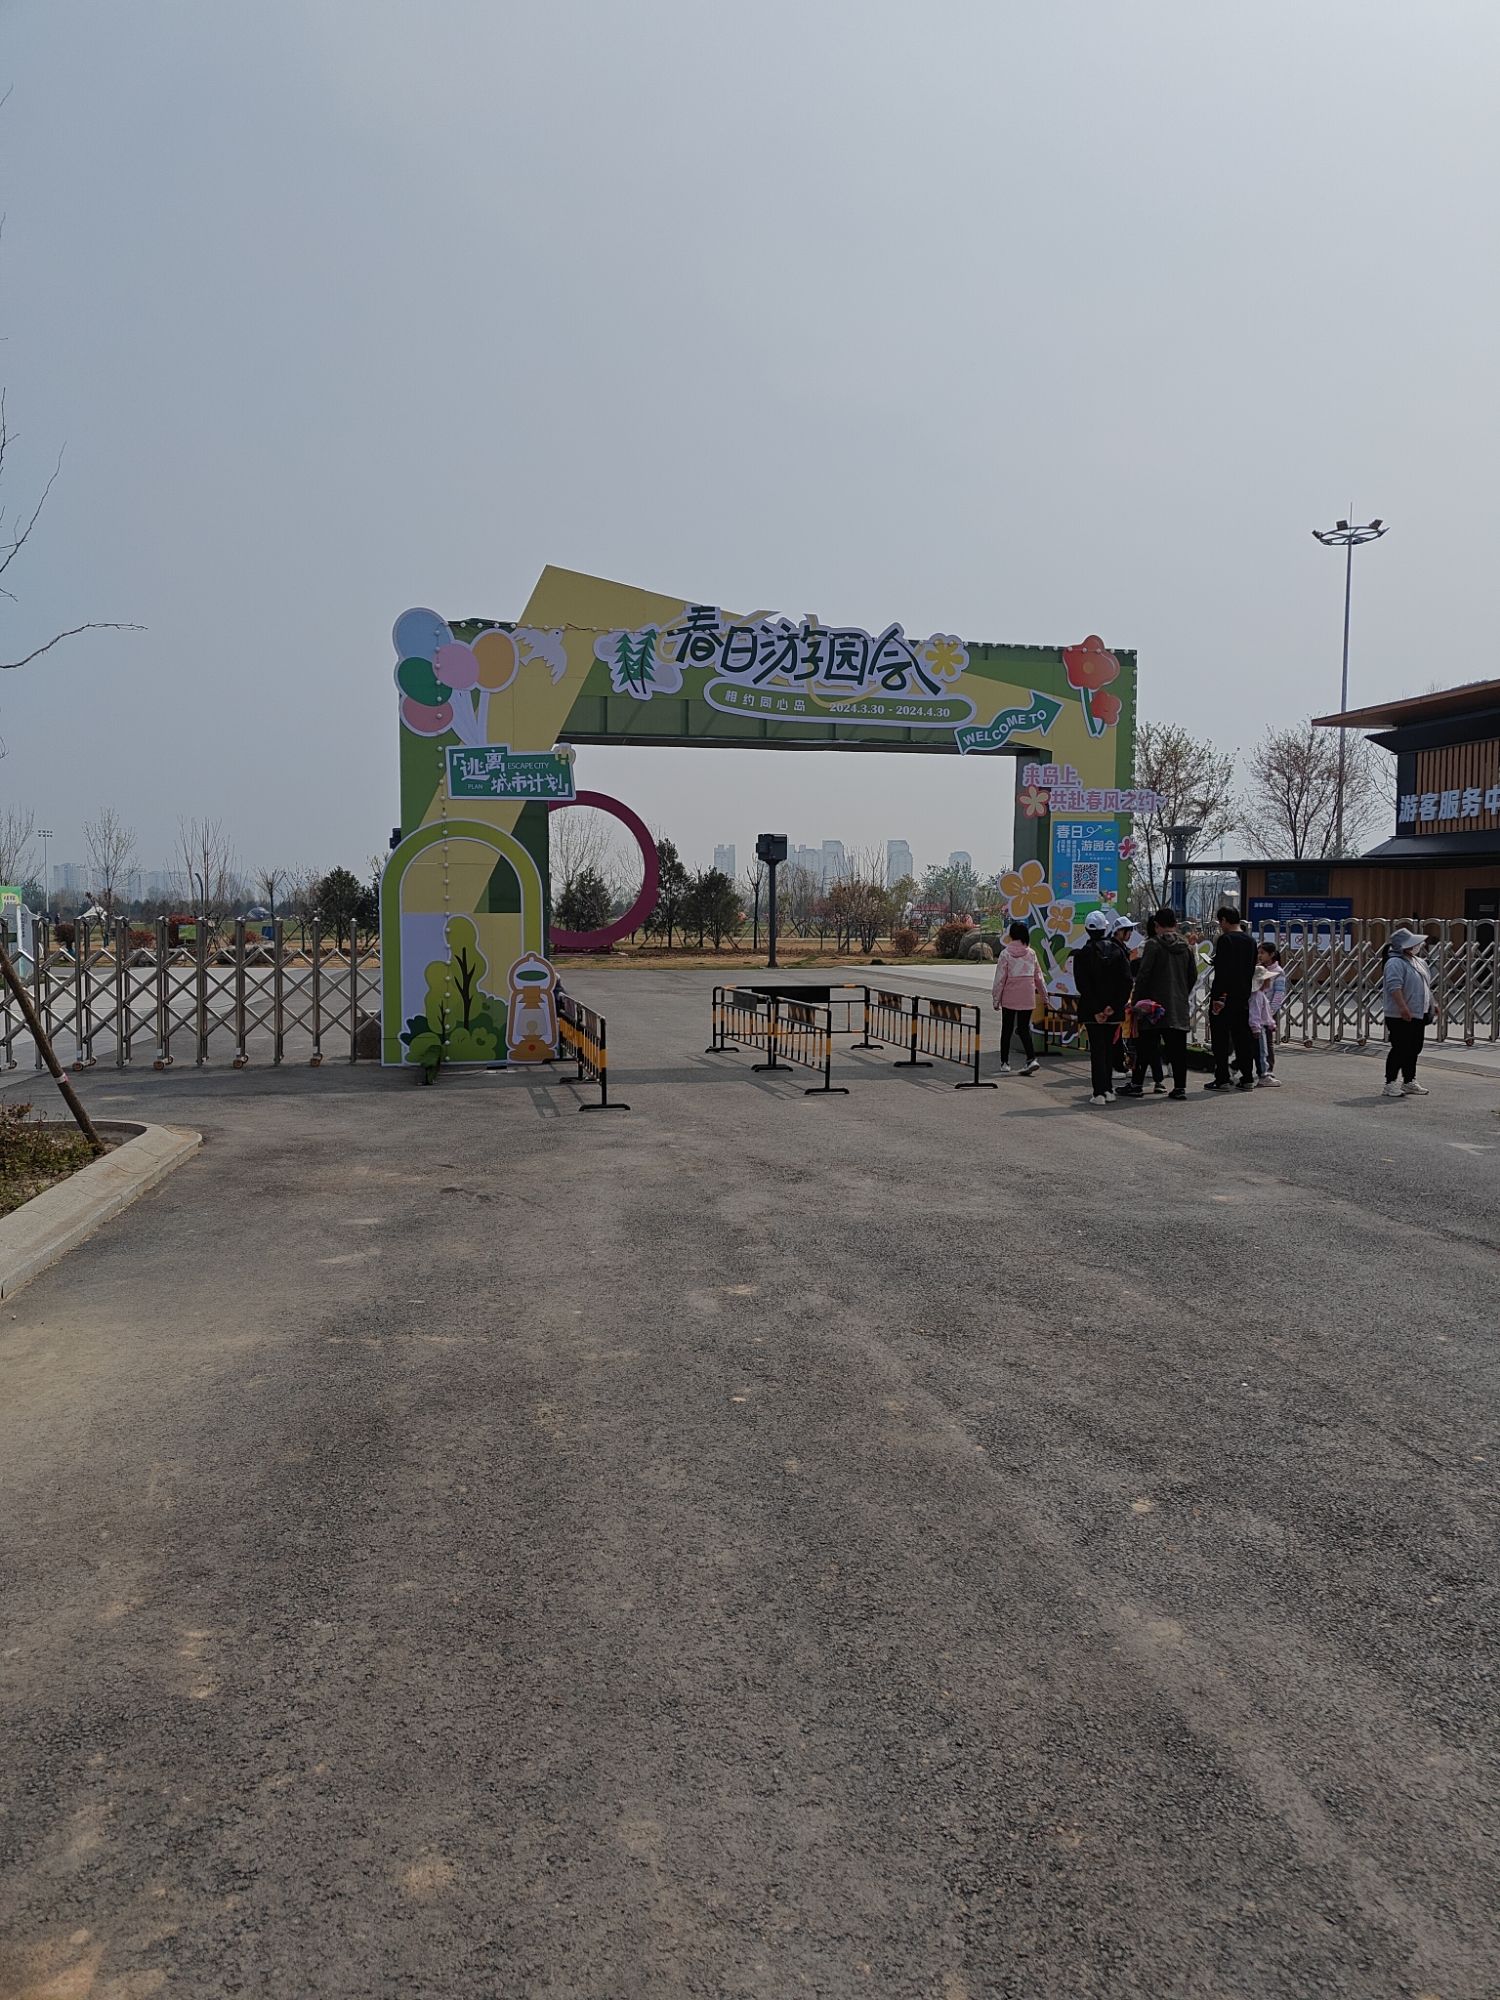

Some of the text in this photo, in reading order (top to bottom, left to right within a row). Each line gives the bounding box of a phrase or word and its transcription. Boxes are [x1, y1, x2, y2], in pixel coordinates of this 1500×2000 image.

[667, 606, 942, 696] 春日游园会
[725, 690, 805, 712] 相约同心岛
[829, 703, 885, 714] 2024.3.30
[896, 705, 951, 717] 2024.4.30
[963, 710, 1047, 745] WELCOME TO
[1056, 825, 1083, 839] 春日
[1081, 840, 1116, 852] 游园会
